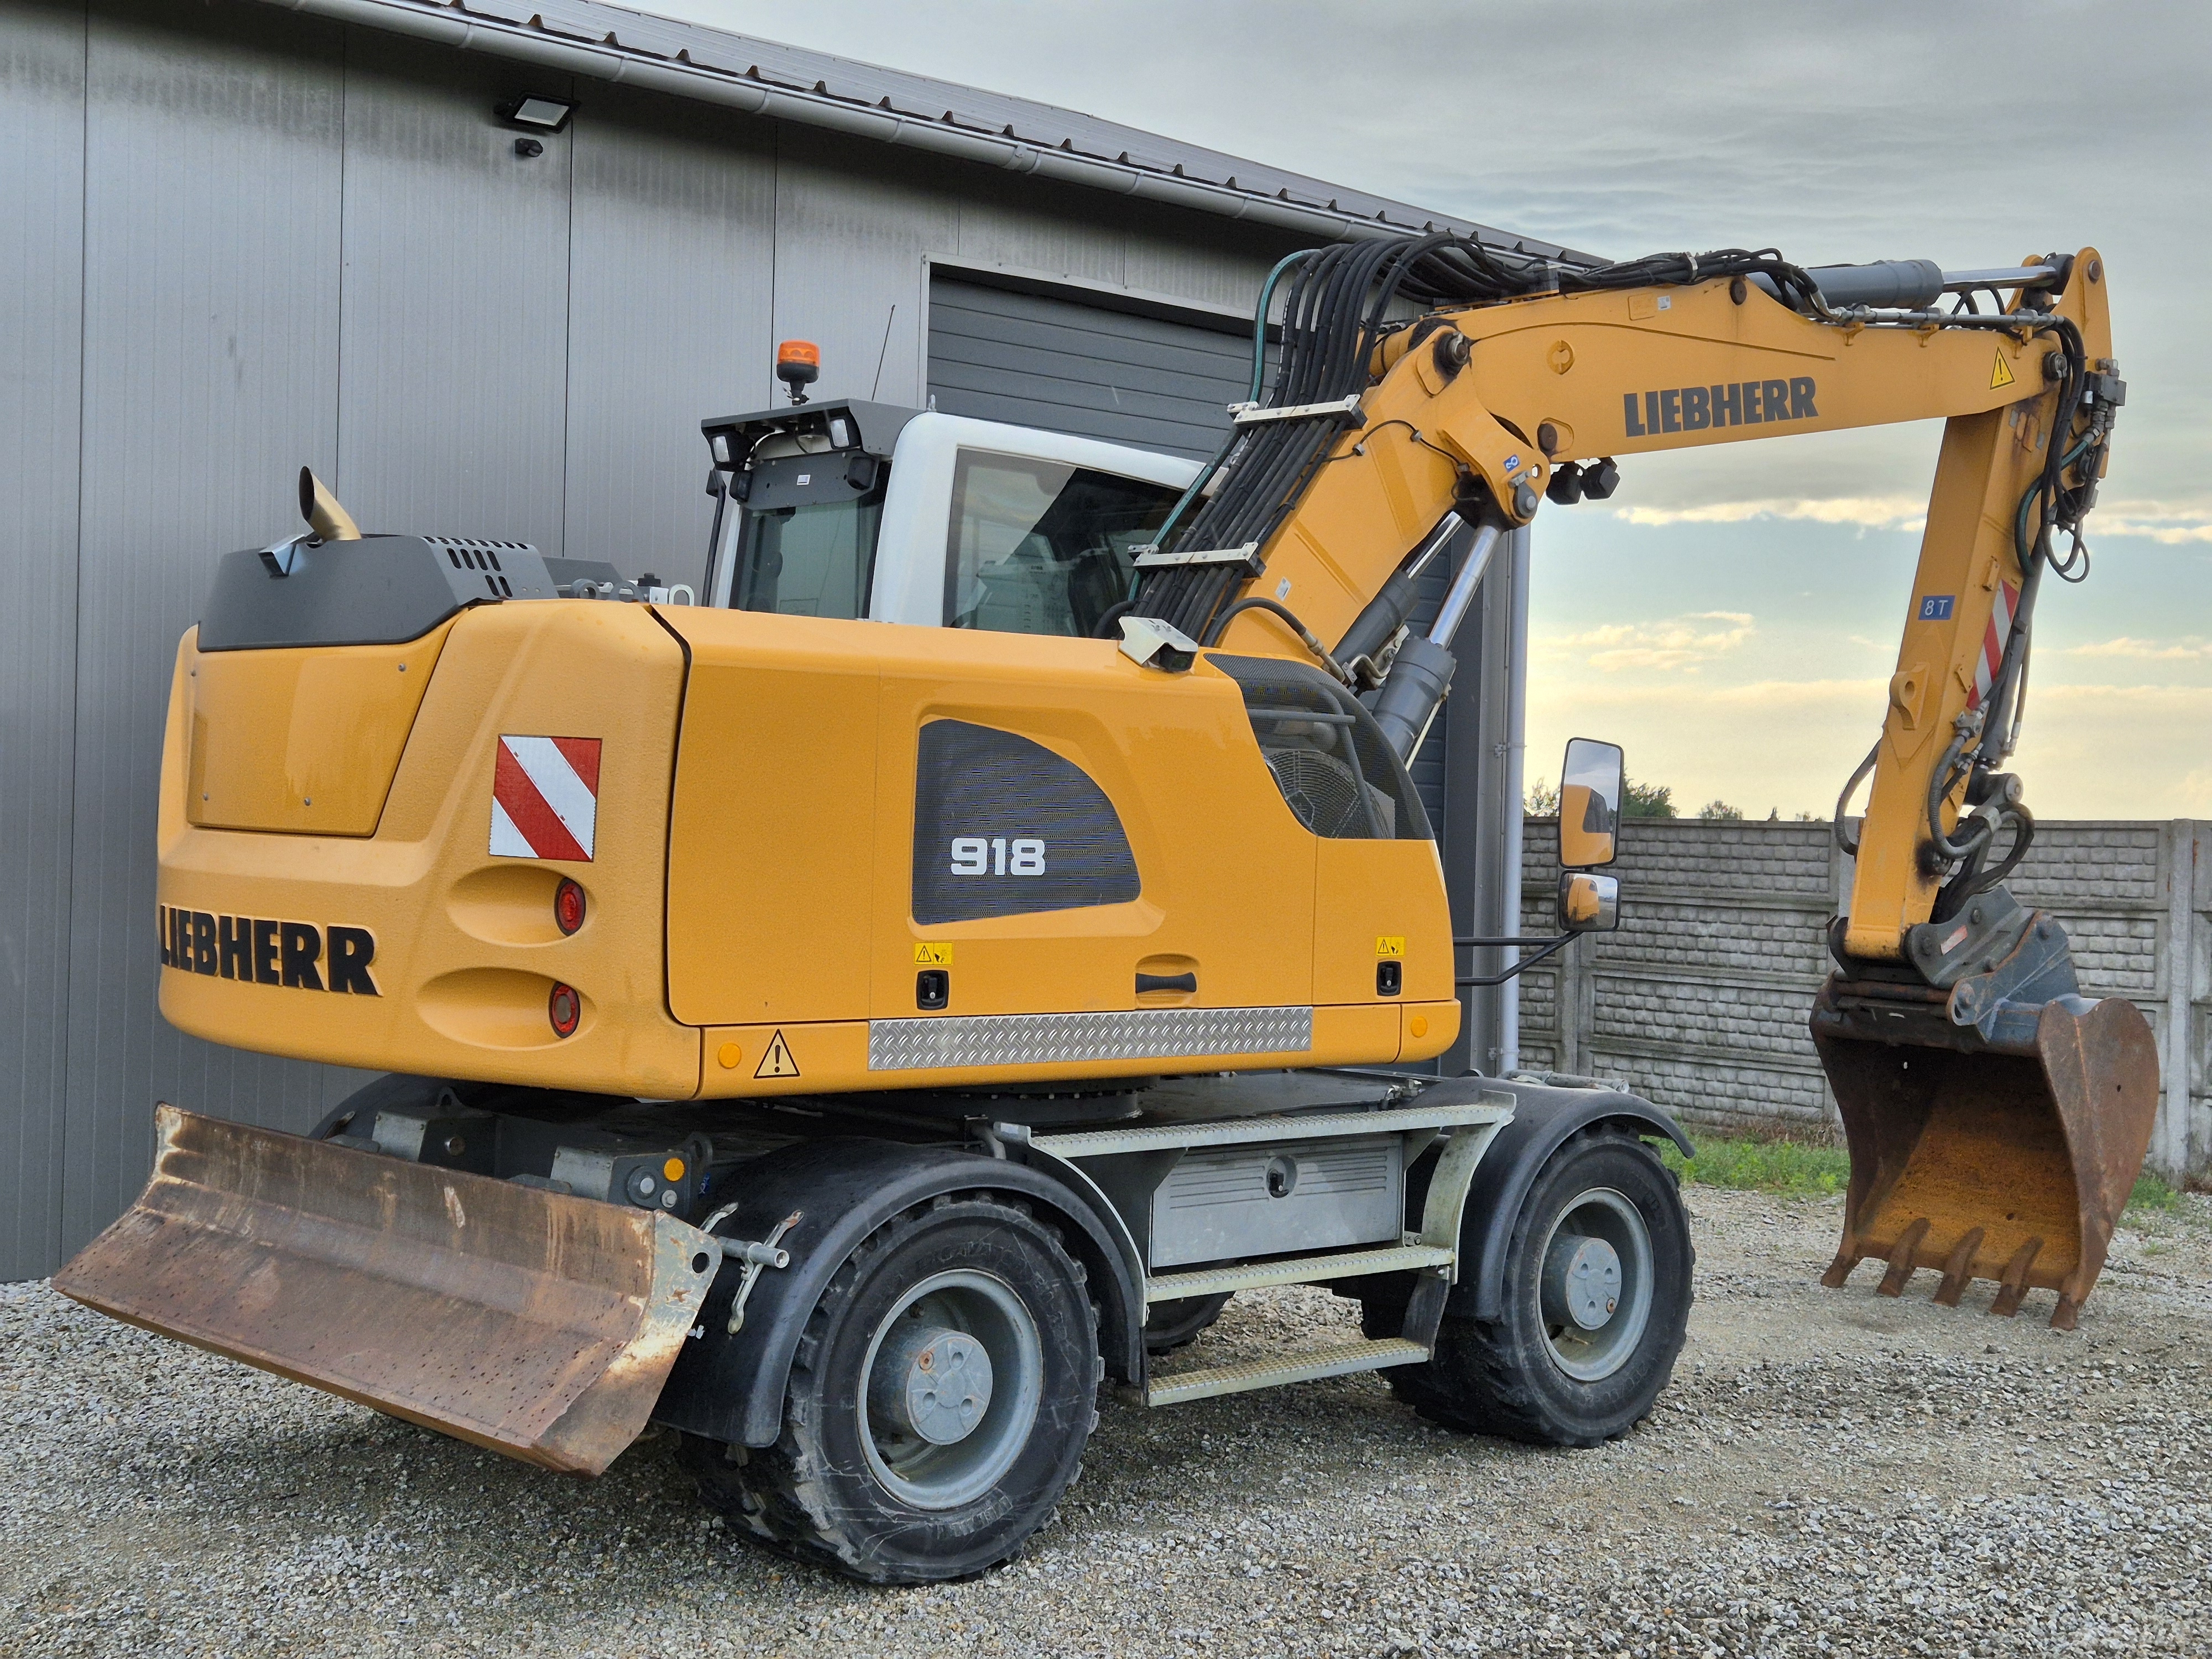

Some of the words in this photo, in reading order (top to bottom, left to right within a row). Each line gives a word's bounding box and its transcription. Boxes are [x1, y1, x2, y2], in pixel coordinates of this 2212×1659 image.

[1624, 377, 1819, 437] LIEBHERR
[1924, 600, 1934, 616] 8
[1938, 599, 1949, 616] T
[951, 838, 1045, 875] 918
[159, 904, 382, 997] LIEBHERR
